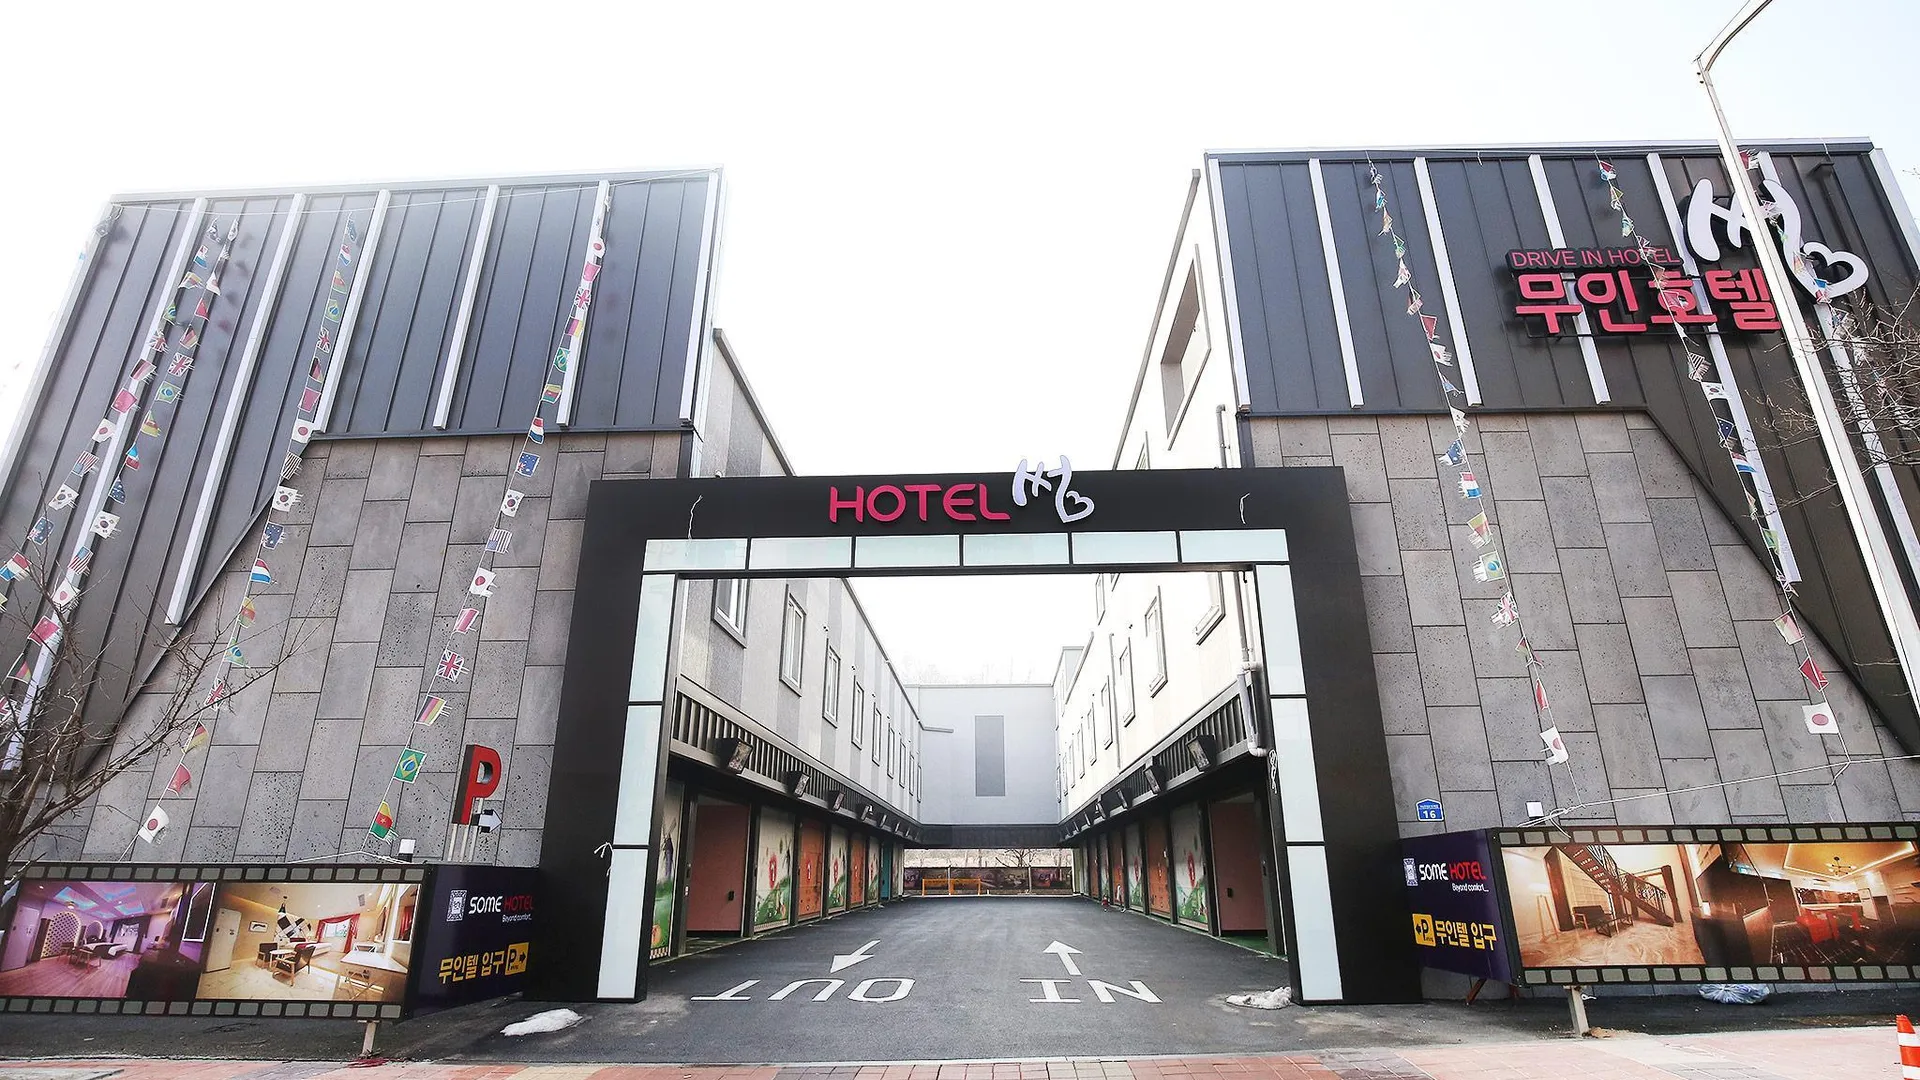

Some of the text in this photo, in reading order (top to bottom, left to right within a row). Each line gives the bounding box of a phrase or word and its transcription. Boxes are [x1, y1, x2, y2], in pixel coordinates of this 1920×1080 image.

[1513, 251, 1577, 267] DRIVE
[1581, 250, 1603, 265] IN
[1515, 268, 1783, 333] 무인호텔
[829, 483, 1011, 523] HOTEL
[452, 745, 502, 825] P
[1423, 810, 1436, 819] 16
[1419, 861, 1487, 880] SOME HOTEL
[468, 895, 534, 914] SOME HOTEL
[1435, 920, 1497, 951] 무인텔 입구
[439, 950, 505, 984] 무인텔 입구
[691, 978, 916, 1003] OUT
[1019, 978, 1163, 1004] IN
